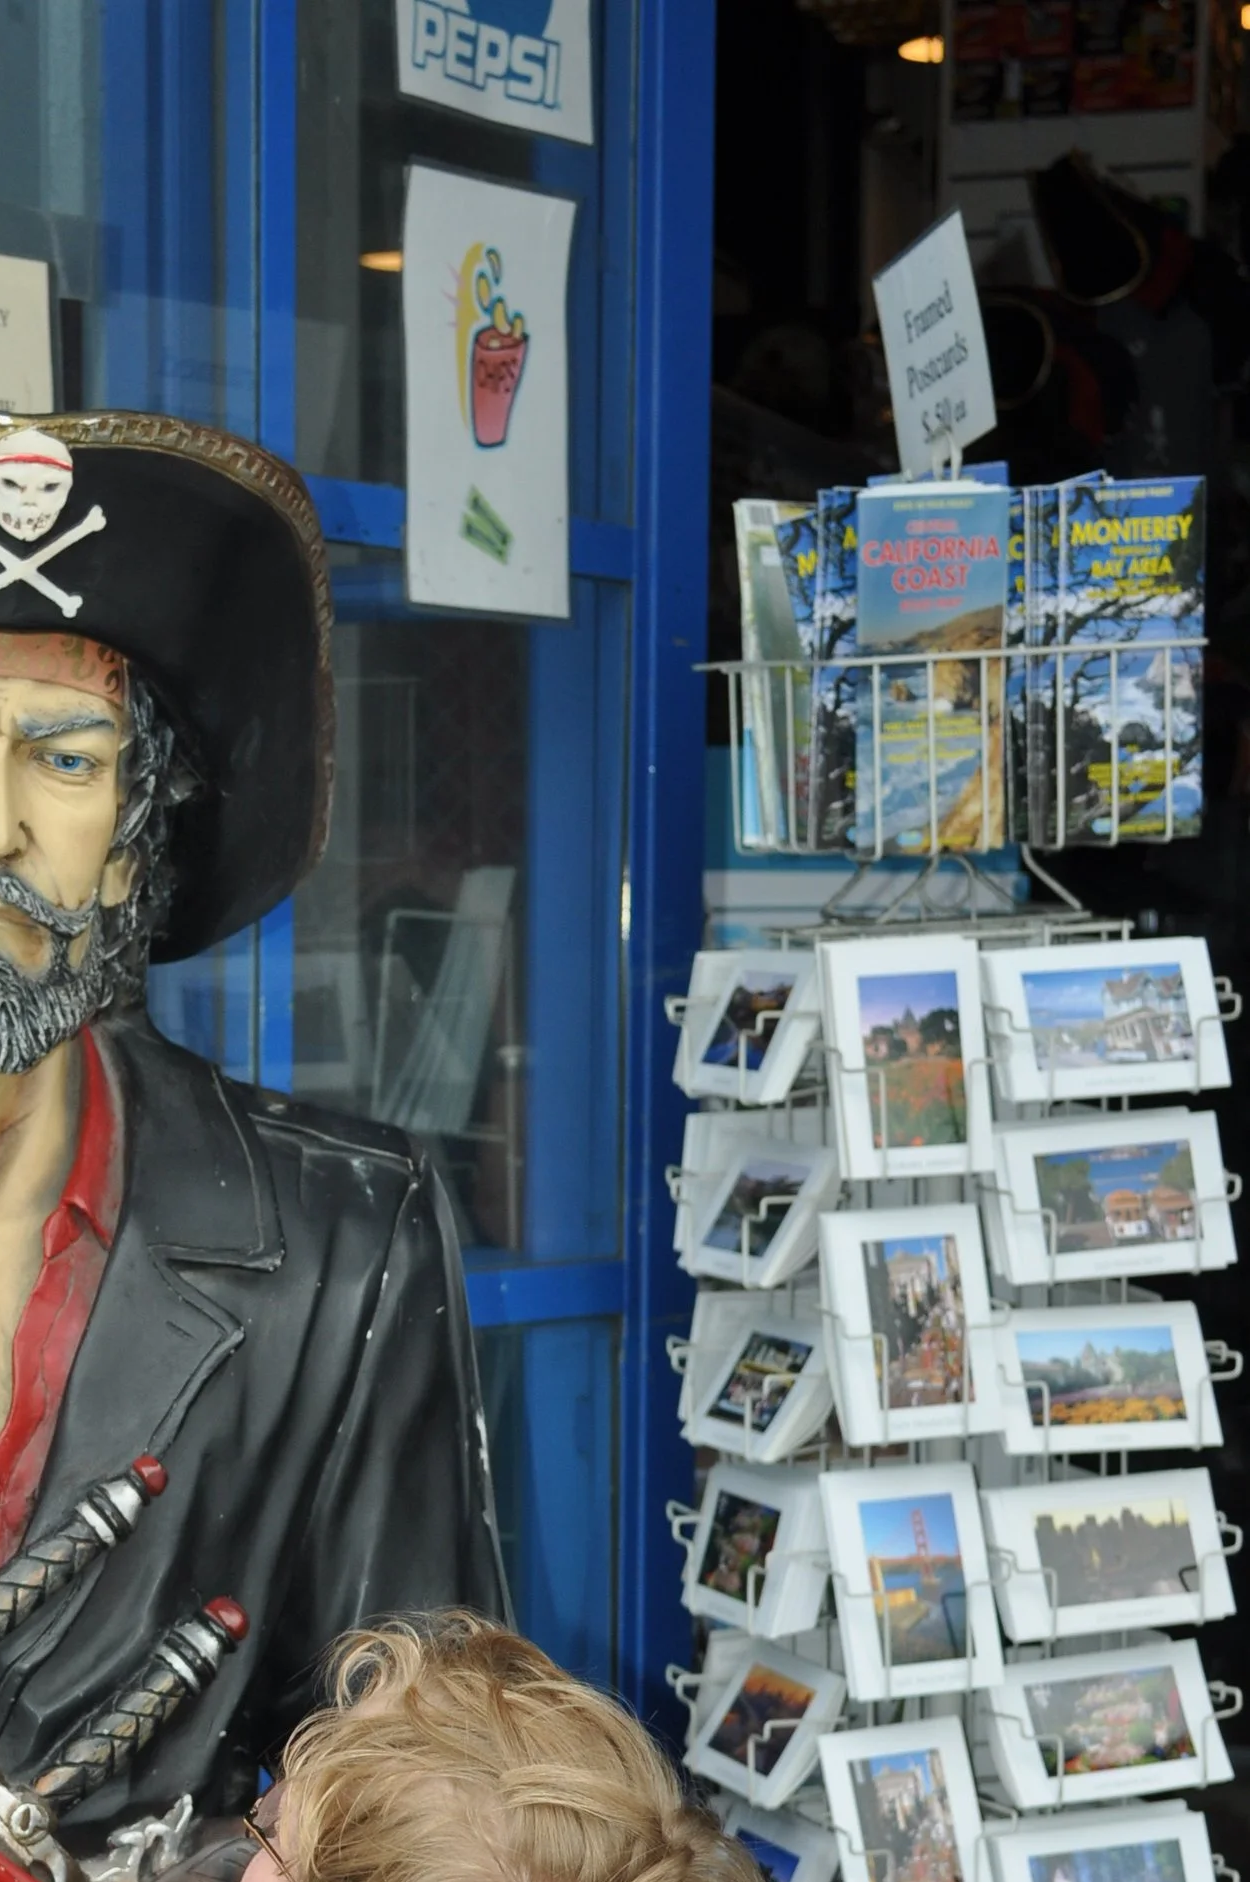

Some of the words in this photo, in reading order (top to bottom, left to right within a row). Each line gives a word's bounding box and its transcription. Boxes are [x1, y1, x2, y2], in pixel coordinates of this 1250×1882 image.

[412, 2, 561, 109] PEPSI
[903, 278, 954, 344] Framed
[906, 330, 969, 399] Postcards
[861, 534, 1000, 568] CALIFORNIA
[1070, 514, 1193, 546] MONTEREY
[891, 563, 969, 595] COAST
